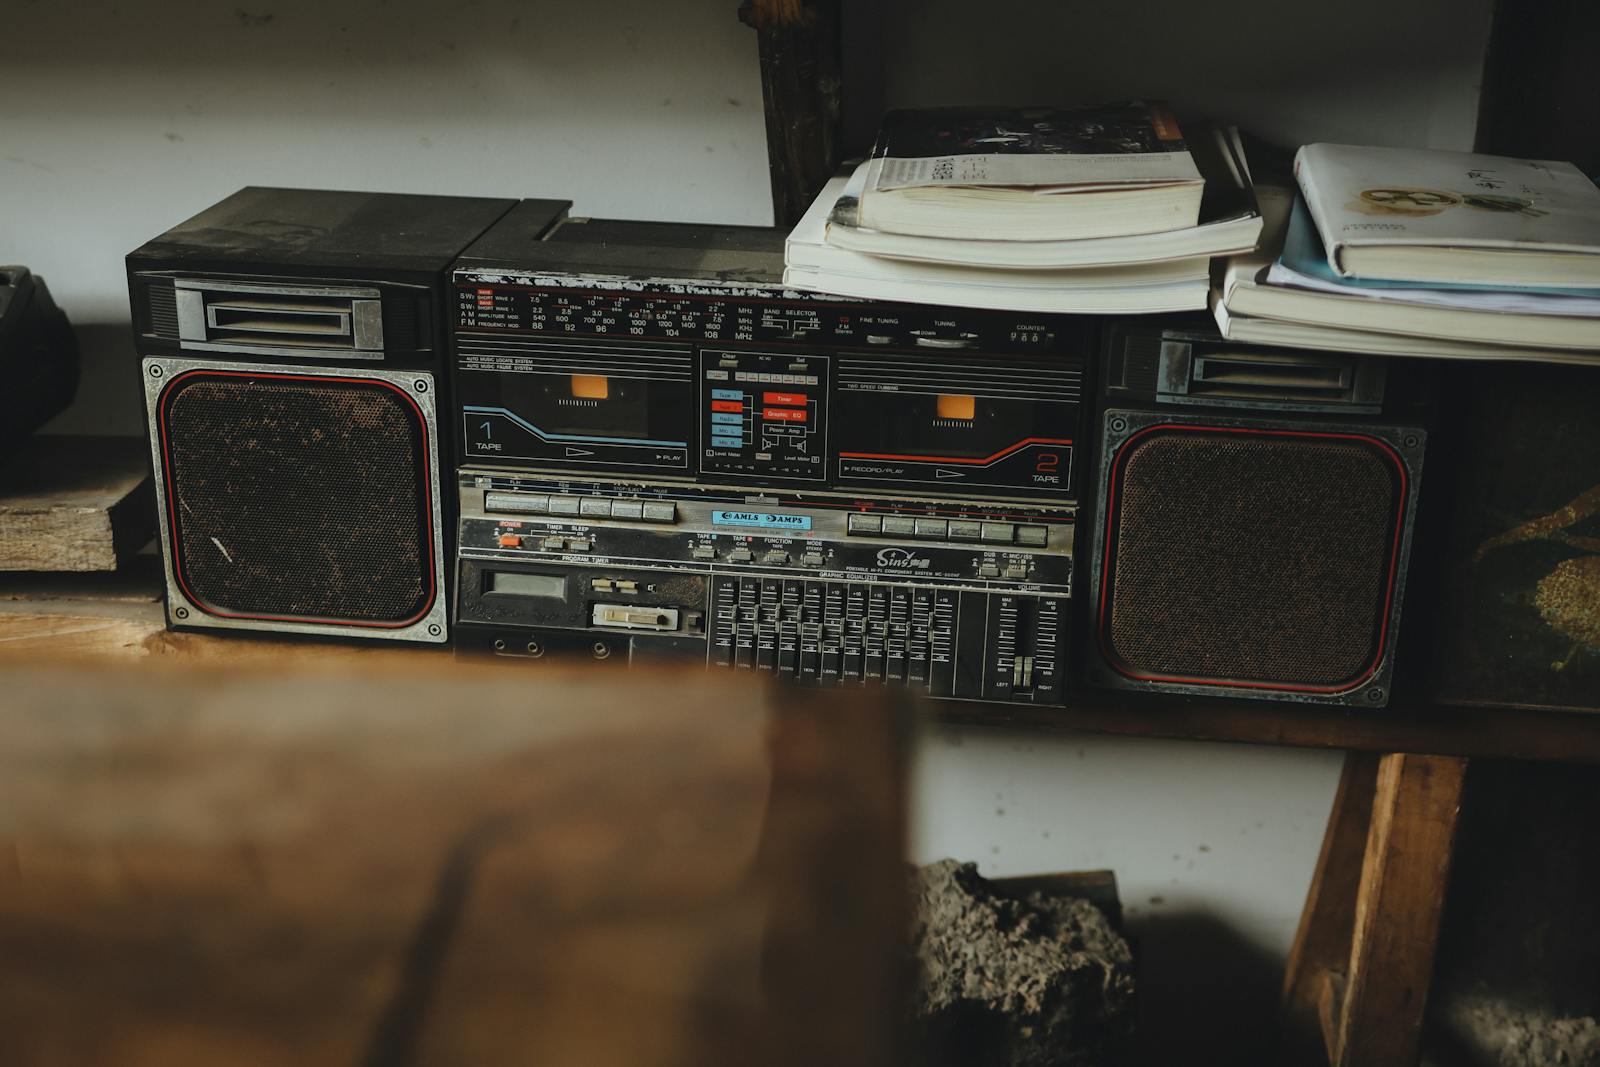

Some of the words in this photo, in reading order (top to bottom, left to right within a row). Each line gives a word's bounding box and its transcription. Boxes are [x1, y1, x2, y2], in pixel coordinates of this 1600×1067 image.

[785, 309, 817, 317] SELECTOR
[658, 320, 673, 328] 1200
[934, 320, 956, 328] TUNING
[532, 322, 543, 330] 88
[595, 325, 607, 333] 96
[629, 327, 644, 335] 100
[665, 329, 679, 337] 104
[704, 331, 719, 339] 108
[735, 332, 753, 340] MHz
[480, 421, 491, 440] 1
[475, 442, 502, 451] TAPE
[662, 454, 681, 462] PLAY
[1036, 453, 1059, 472] 2
[851, 466, 904, 474] RECORD/PLAY
[1032, 474, 1059, 484] TAPE
[734, 513, 759, 521] AMLS
[562, 555, 589, 563] PROGRAM
[820, 571, 844, 579] GRAPHIC
[847, 573, 878, 581] EQUALIZER
[1017, 584, 1041, 592] VOLUME
